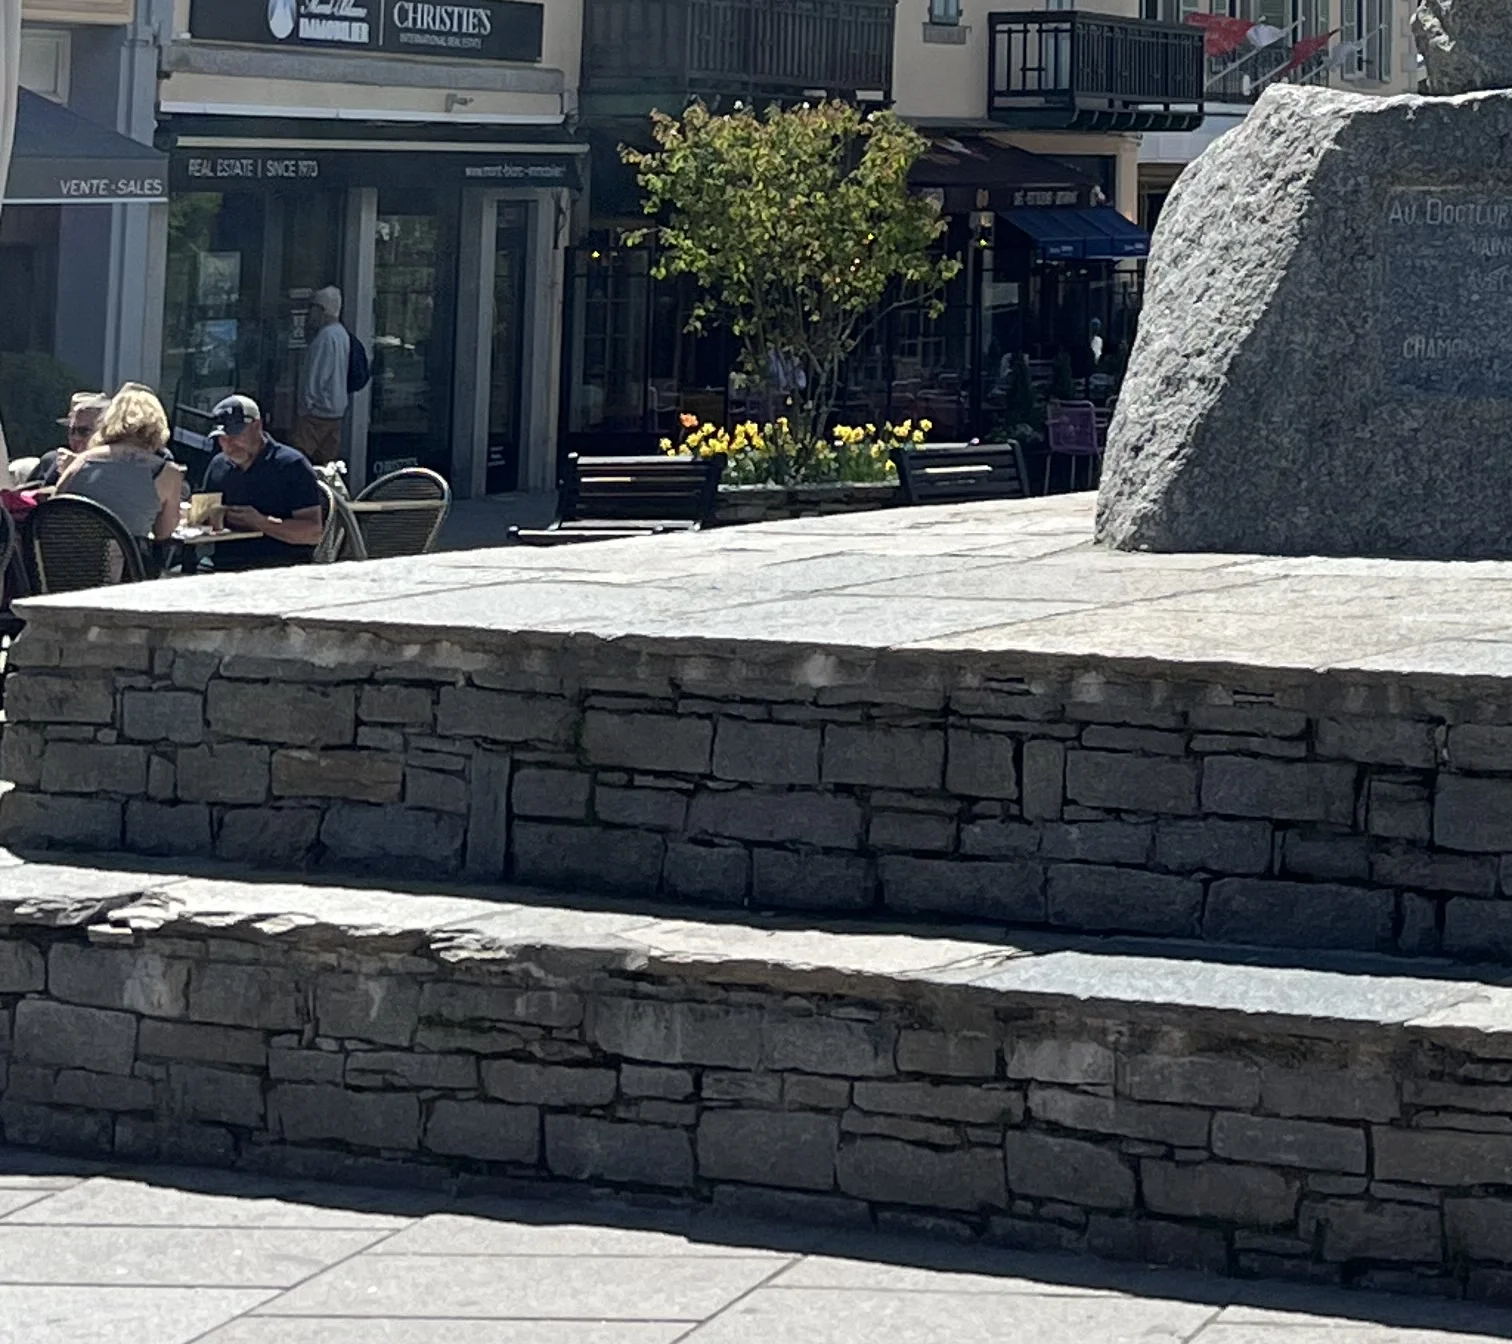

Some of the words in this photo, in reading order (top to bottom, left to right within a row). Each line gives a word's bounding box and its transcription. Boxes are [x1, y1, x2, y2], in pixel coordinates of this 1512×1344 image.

[393, 0, 492, 35] CHRISTIE'S
[188, 158, 215, 177] REAL
[216, 158, 253, 177] ESTATE
[266, 159, 296, 177] SINCE
